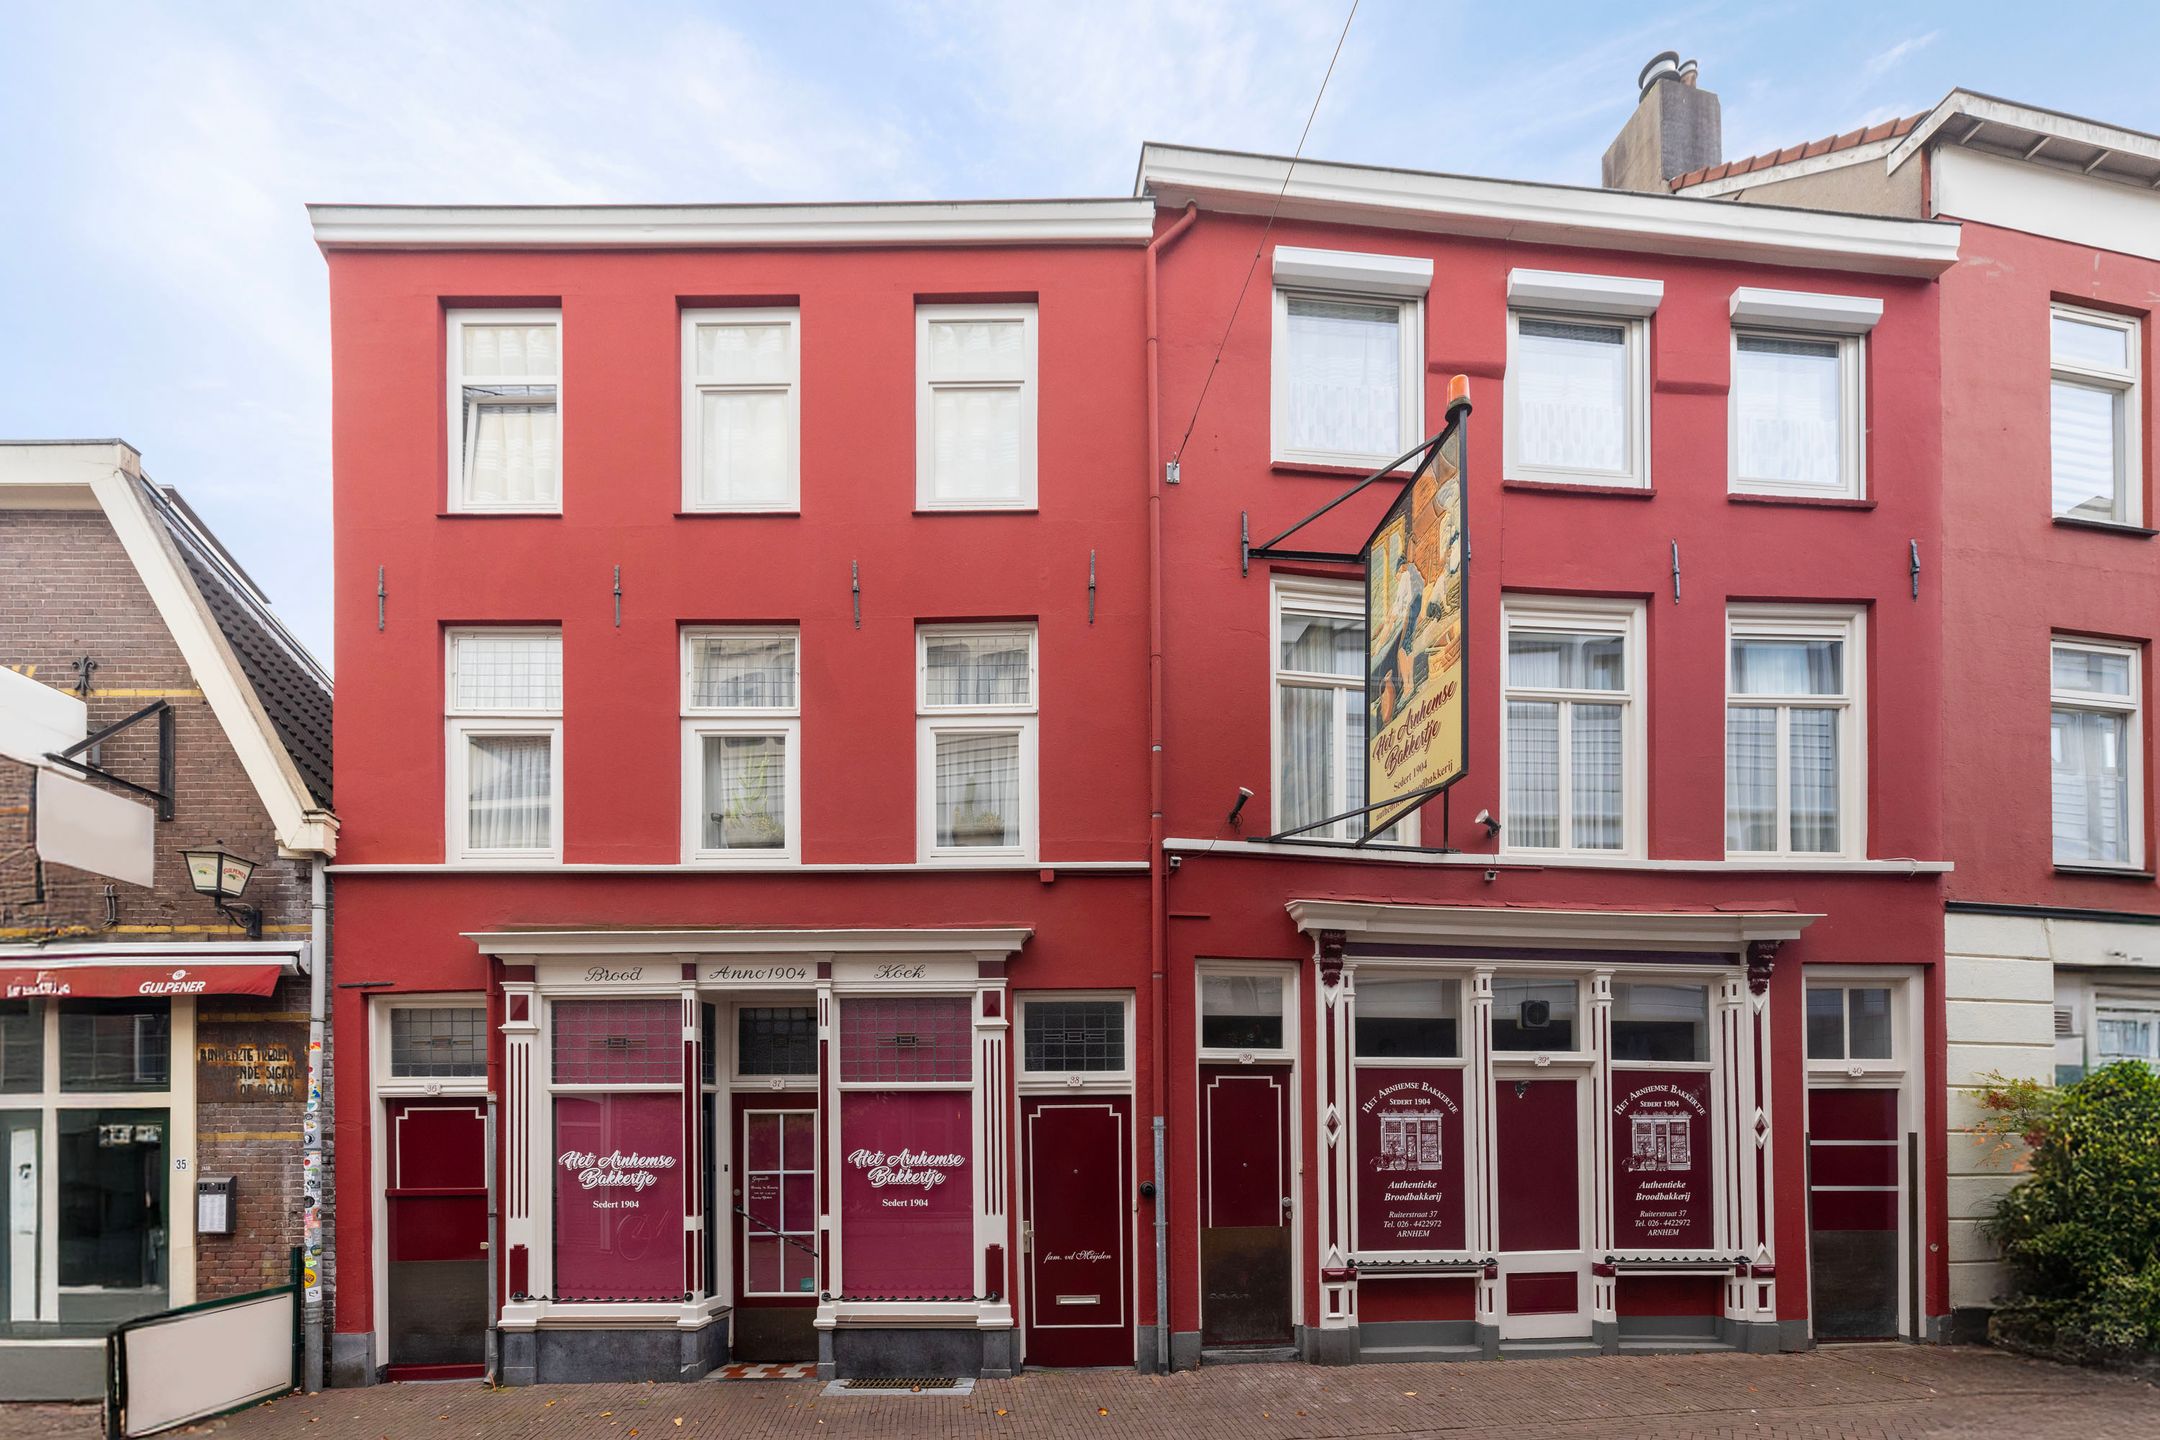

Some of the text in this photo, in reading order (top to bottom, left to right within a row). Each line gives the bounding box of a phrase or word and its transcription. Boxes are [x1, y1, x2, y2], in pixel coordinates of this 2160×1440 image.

[1372, 680, 1458, 761] Het Arnhemse
[1384, 719, 1442, 779] Bakkertje
[1393, 759, 1428, 793] Sedert 1904
[584, 966, 643, 982] Brood
[708, 965, 807, 980] Anno 1904
[873, 963, 927, 979] Koek
[138, 980, 207, 994] GULPENER
[1852, 1066, 1863, 1075] 40
[772, 1079, 782, 1088] 37
[1070, 1075, 1080, 1085] 38
[1361, 1081, 1459, 1115] HET ARNHEMSE BAKKERTJE
[1414, 1098, 1431, 1106] 1904
[1614, 1084, 1707, 1117] HET ARNHEMSE BAKKERTJE
[1663, 1100, 1680, 1108] 1904
[558, 1149, 677, 1171] Het Arnhemse
[847, 1147, 966, 1169] Het Arnhemse
[176, 1159, 187, 1170] 35
[578, 1167, 658, 1192] Bakkertje
[867, 1165, 947, 1191] Bakkertje
[1388, 1180, 1438, 1189] Authentieke
[1638, 1180, 1687, 1189] Authentieke
[1384, 1192, 1443, 1202] Broodbakkerij
[1635, 1192, 1691, 1202] Broodbakkerij
[592, 1200, 640, 1209] Sedert 1904
[882, 1198, 929, 1207] Sedert 1904
[1428, 1210, 1438, 1218] 37
[1639, 1209, 1687, 1218] Ruiterstraat 37
[1383, 1220, 1395, 1228] Tel.
[1396, 1220, 1409, 1228] 026
[1413, 1220, 1442, 1228] 4422972
[1634, 1219, 1646, 1227] Tel.
[1647, 1219, 1660, 1227] 026
[1396, 1229, 1431, 1238] ARNHEM
[1647, 1228, 1680, 1237] ARNHEM
